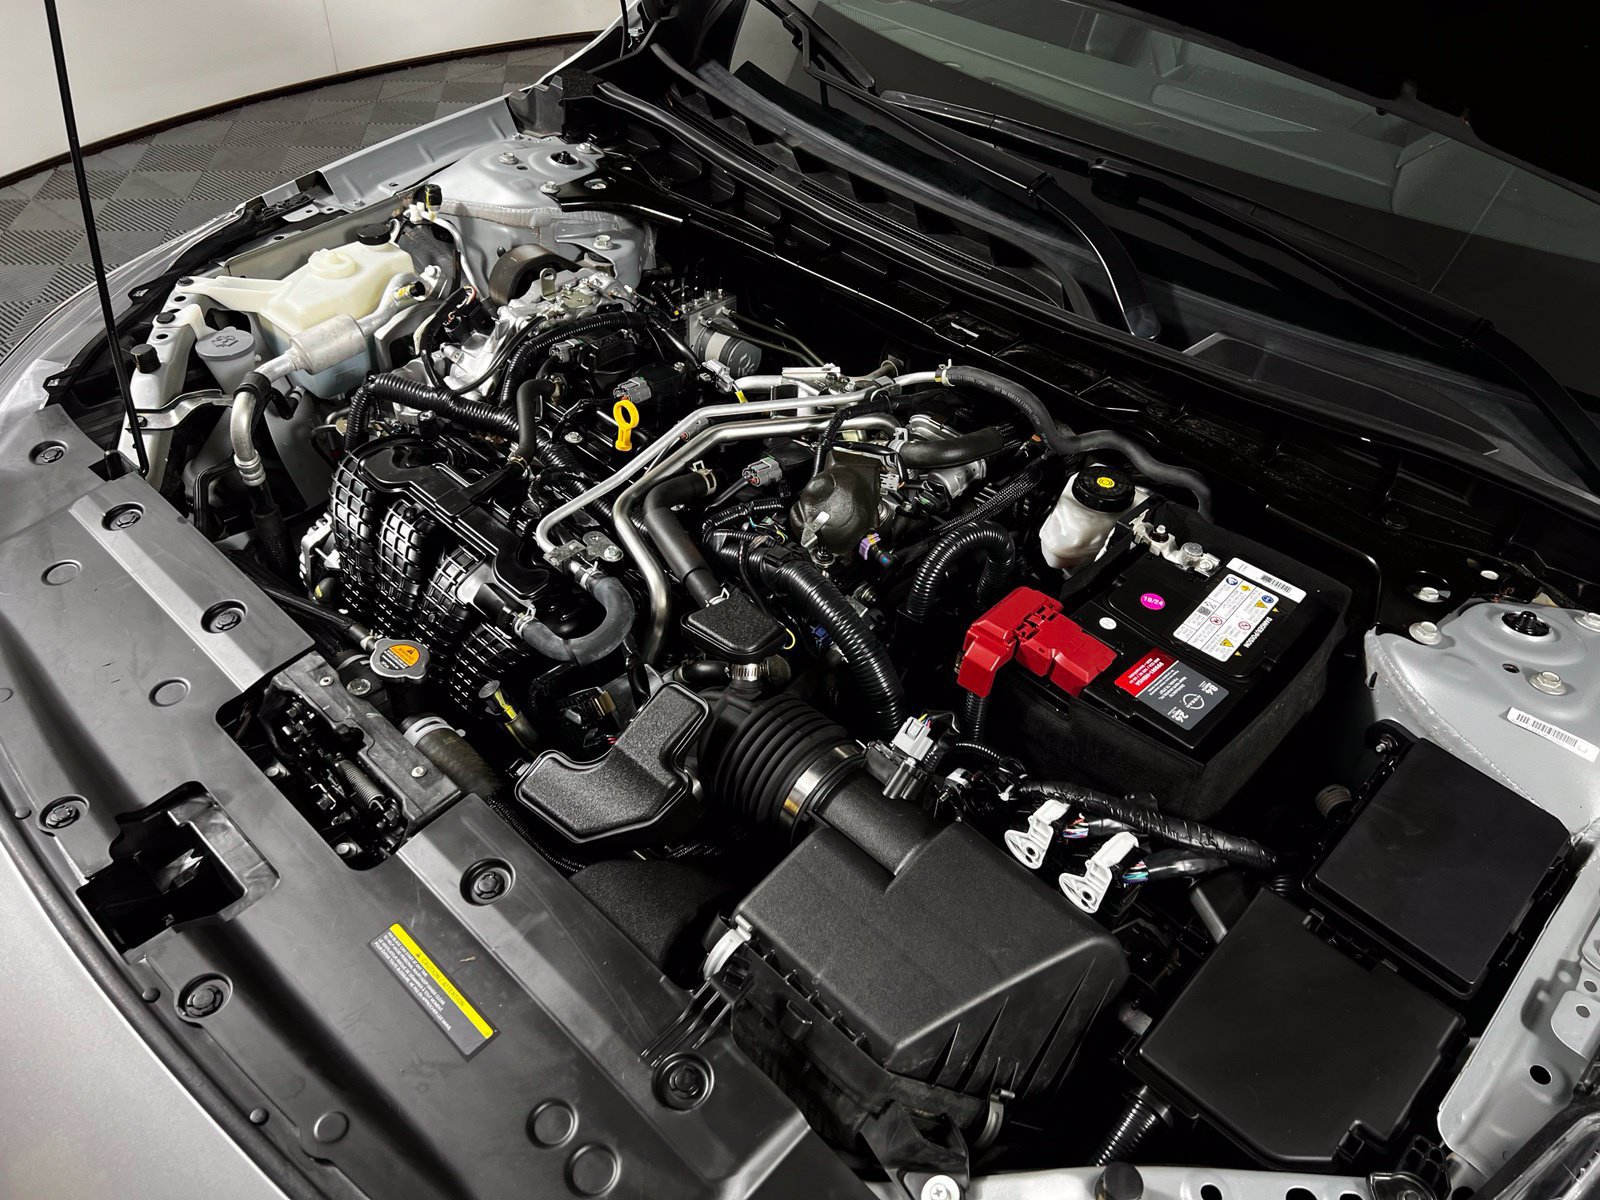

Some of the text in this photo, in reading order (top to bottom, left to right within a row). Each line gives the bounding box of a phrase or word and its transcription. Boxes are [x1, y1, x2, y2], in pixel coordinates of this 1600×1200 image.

[1203, 684, 1219, 696] 84
[1185, 694, 1201, 708] NISSAN
[1173, 711, 1189, 723] 24
[421, 957, 441, 979] CAUTION
[441, 980, 465, 1007] ATTENTION
